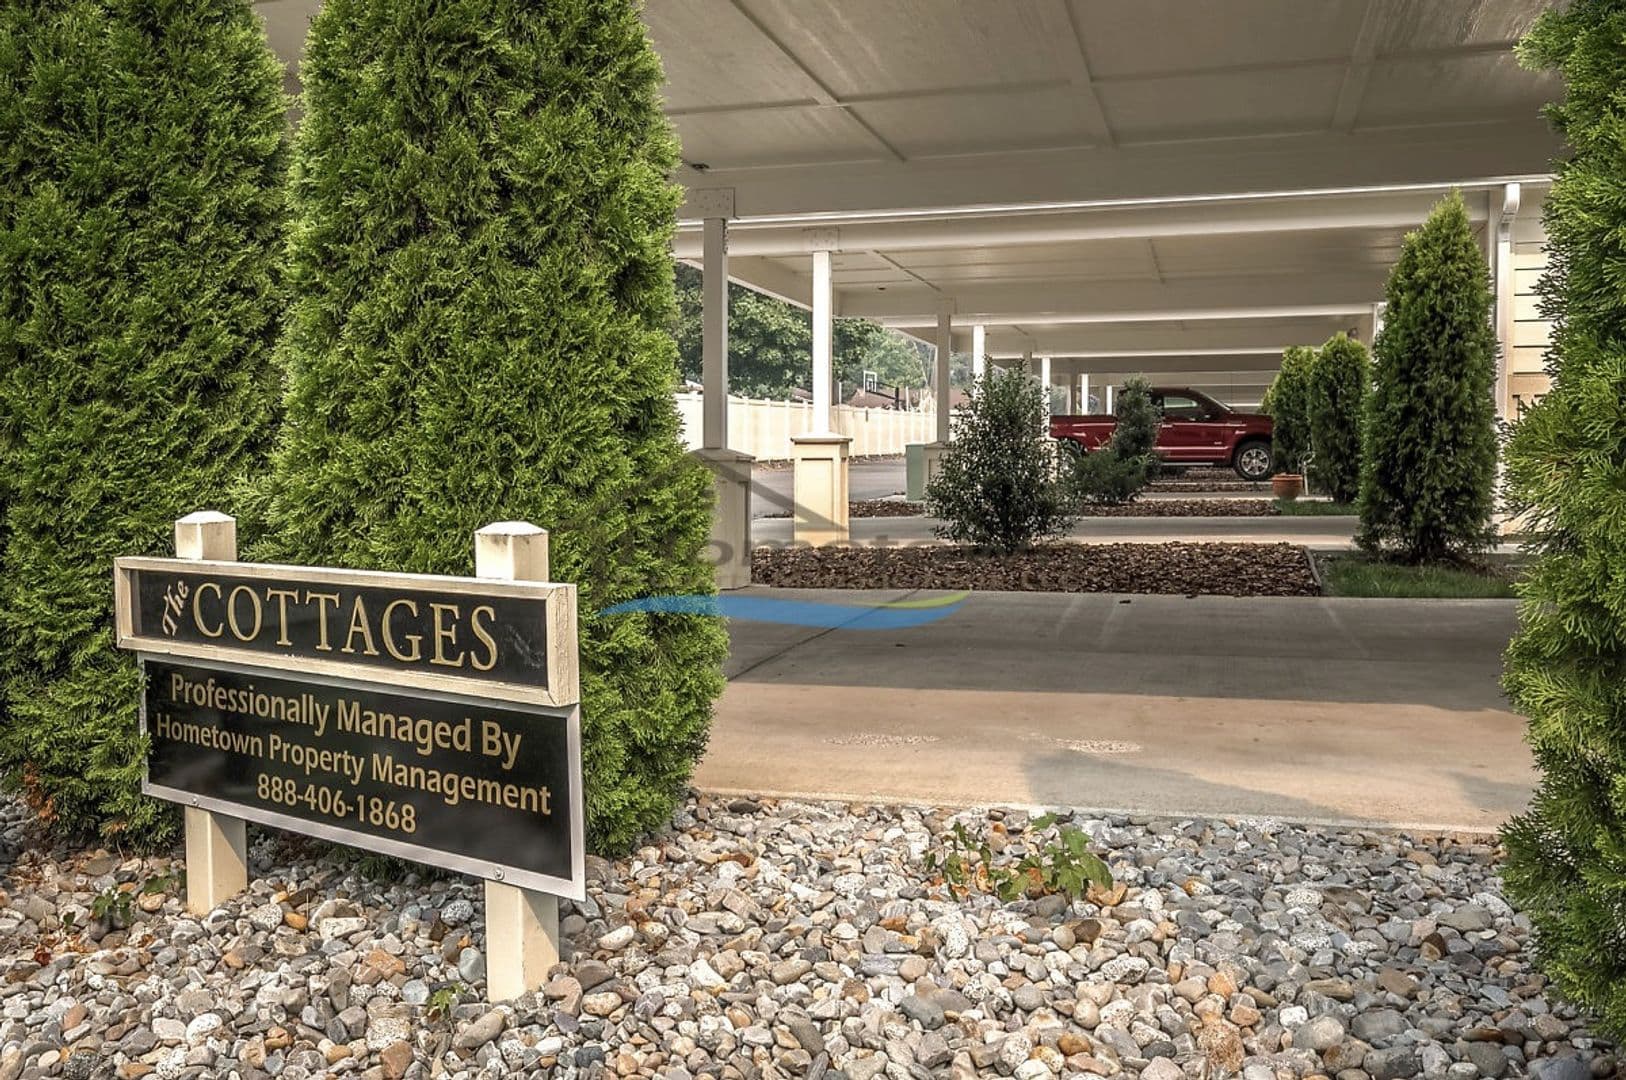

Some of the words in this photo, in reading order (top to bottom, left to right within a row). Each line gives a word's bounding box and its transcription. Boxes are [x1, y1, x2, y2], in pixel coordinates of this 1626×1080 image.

[161, 579, 190, 637] The
[192, 582, 499, 671] COTTAGES
[156, 713, 263, 758] Hometown
[269, 733, 365, 785] Property
[371, 753, 552, 815] Management
[171, 673, 330, 737] Professionally
[336, 699, 472, 756] Managed
[481, 720, 522, 770] By
[257, 773, 417, 834] 888-406-1868
